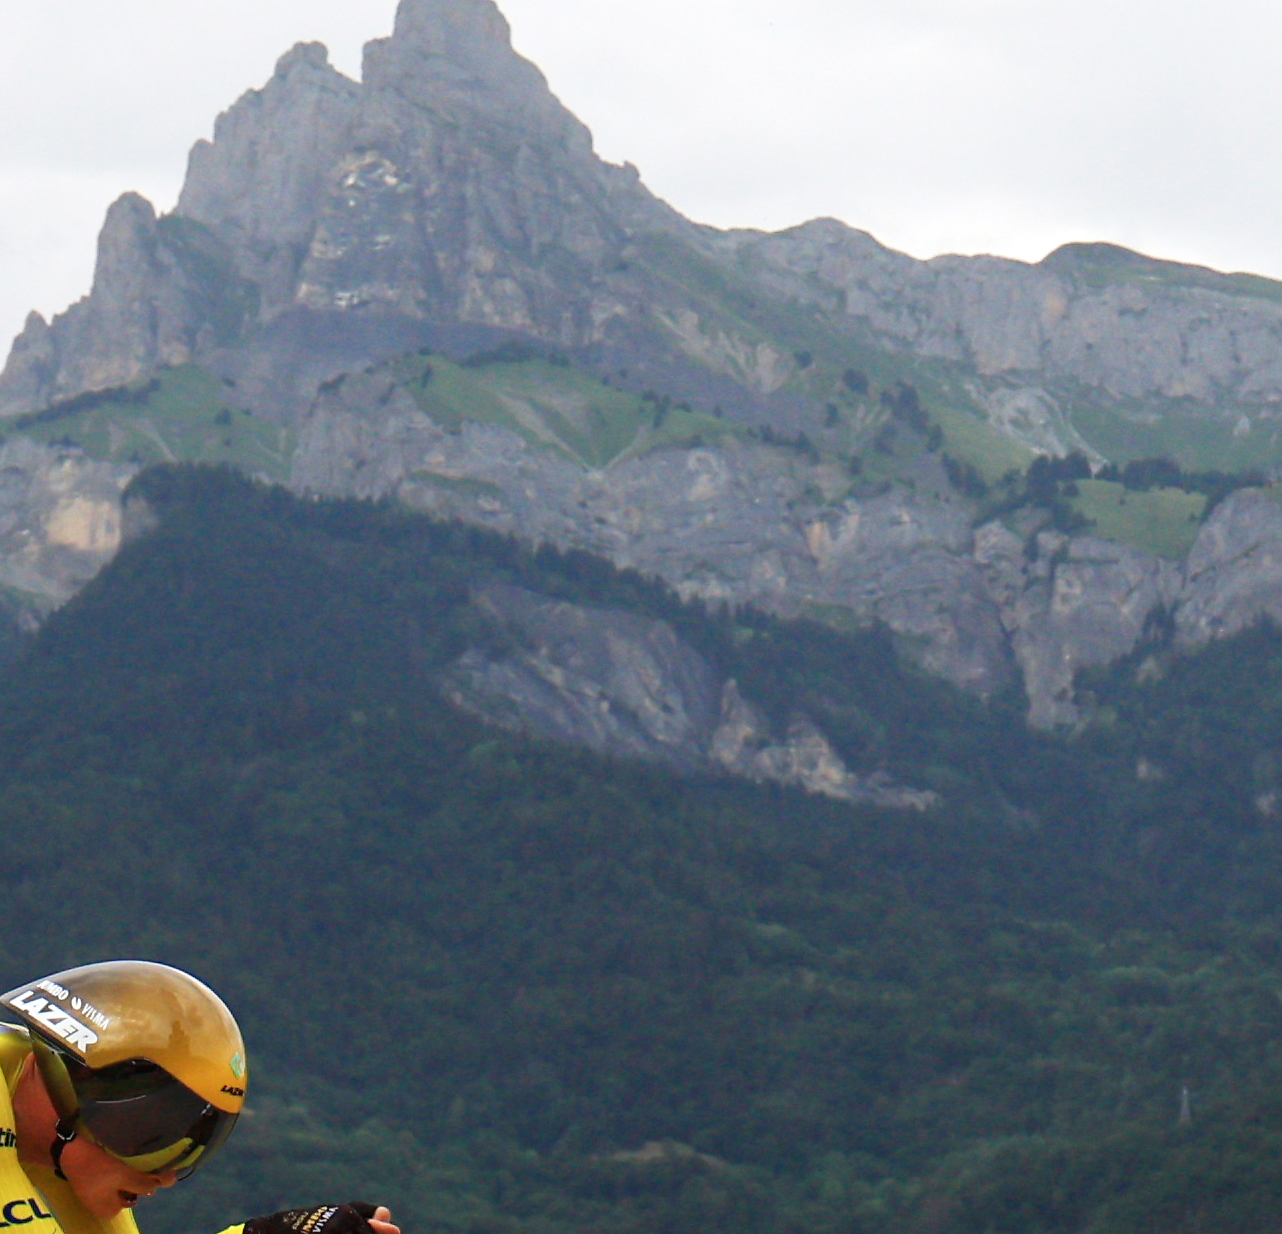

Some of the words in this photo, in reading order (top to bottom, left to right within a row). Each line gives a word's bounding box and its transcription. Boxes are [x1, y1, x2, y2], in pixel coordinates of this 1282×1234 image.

[9, 990, 98, 1053] LAZER
[81, 1003, 111, 1031] VISMA
[312, 1206, 339, 1233] VISMA
